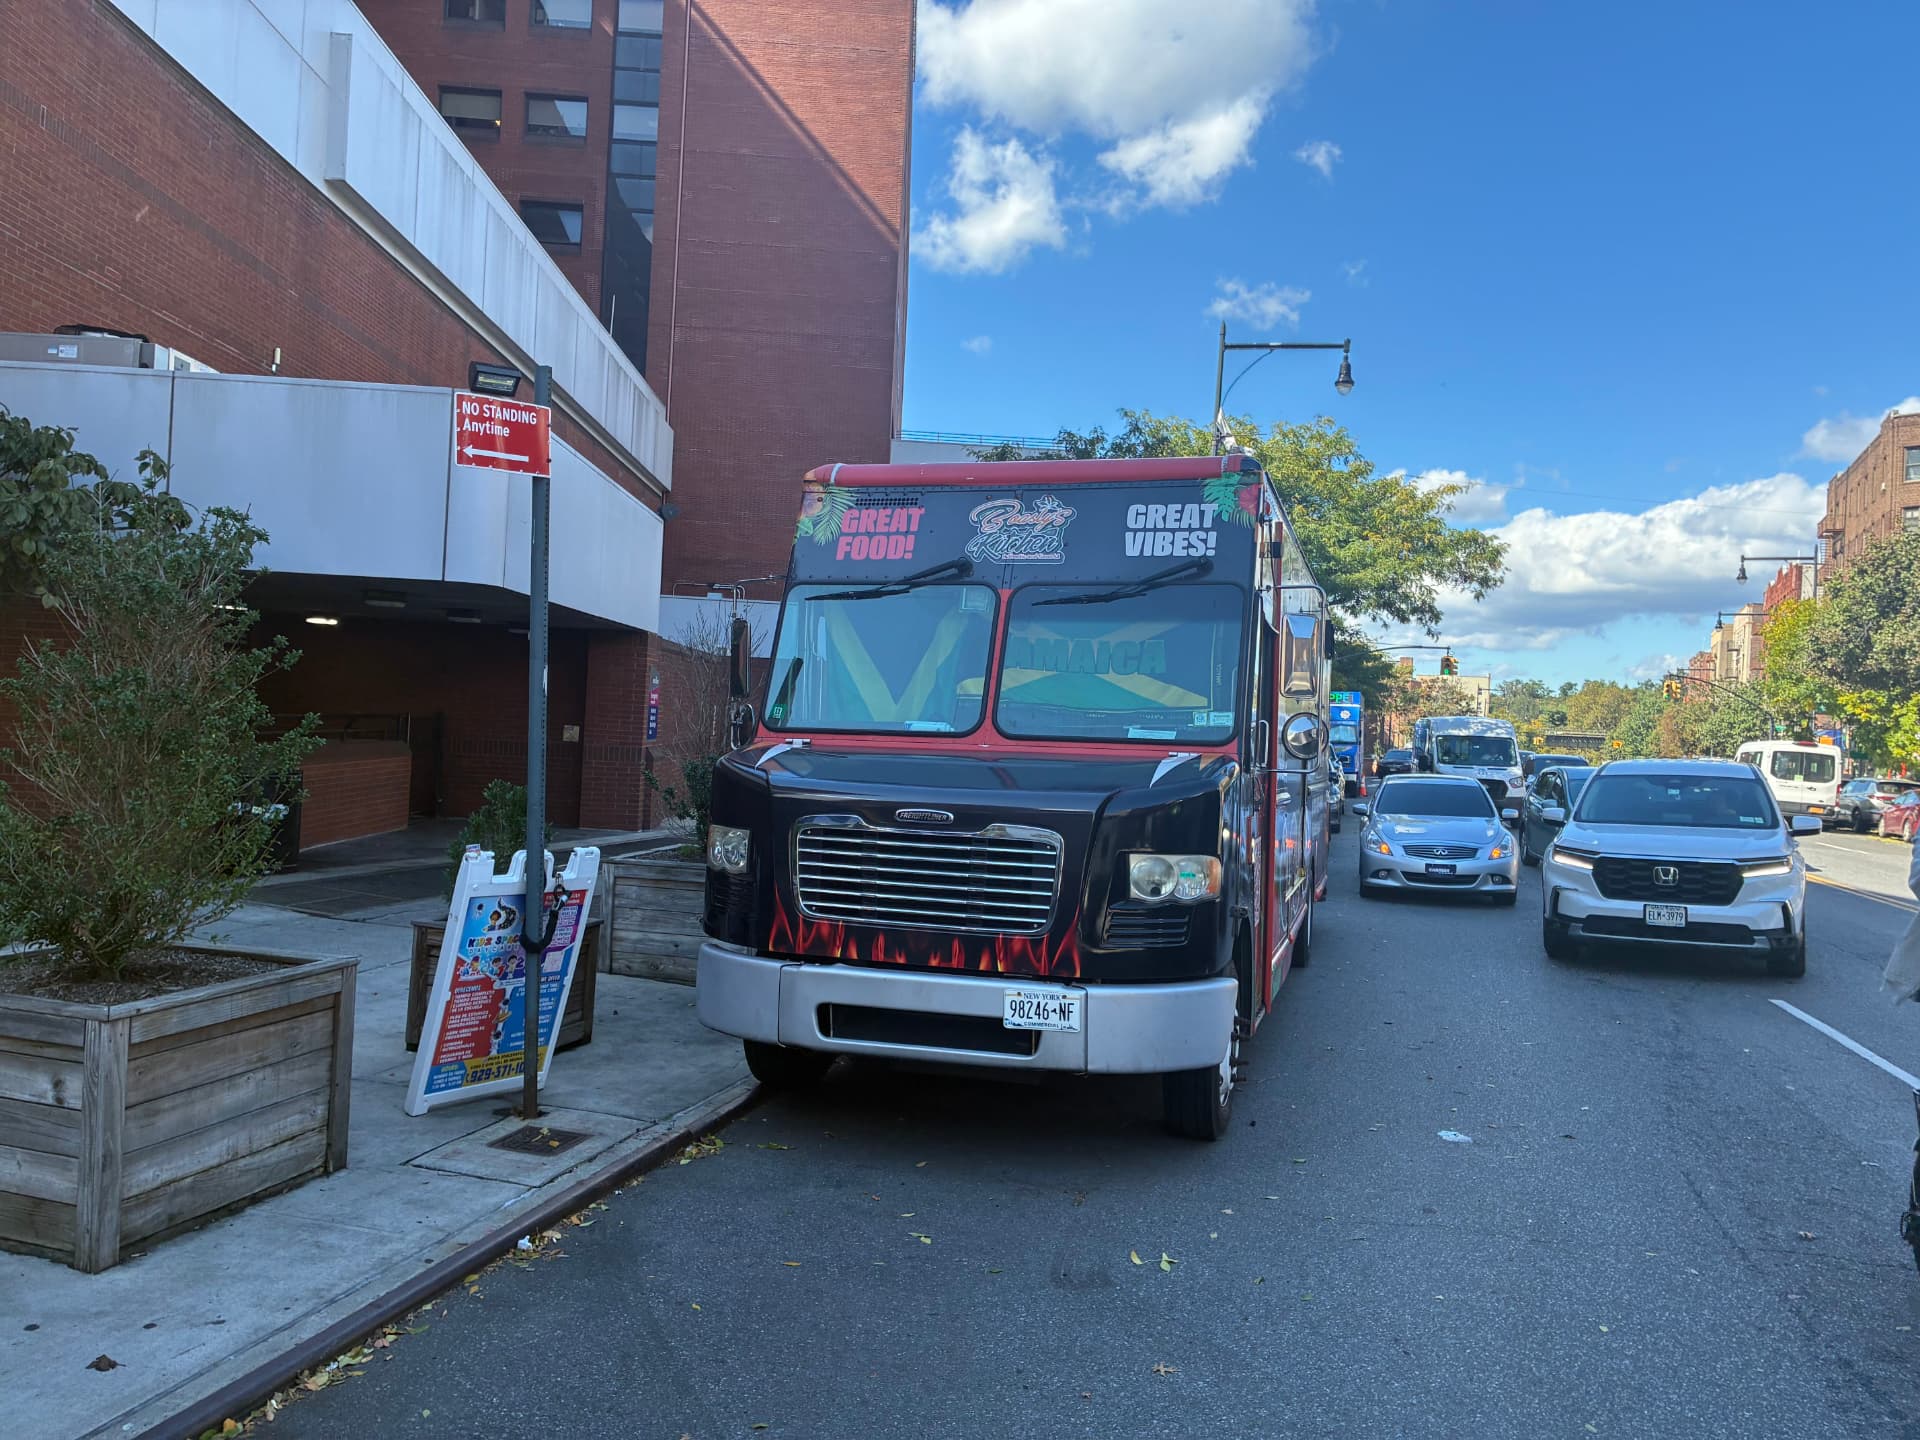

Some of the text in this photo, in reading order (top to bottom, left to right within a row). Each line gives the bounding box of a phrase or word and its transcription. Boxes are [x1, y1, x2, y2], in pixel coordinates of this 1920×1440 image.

[462, 401, 537, 425] NO STANDING
[462, 418, 510, 437] Anytime
[841, 507, 925, 533] GREAT
[1126, 503, 1218, 529] GREAT
[836, 534, 915, 560] FOOD!
[967, 530, 1059, 560] Kitchen
[1125, 530, 1217, 557] VIBES!
[1004, 636, 1167, 675] AMAICA
[495, 934, 520, 945] SPAC
[1023, 992, 1061, 1001] NEW YORK
[1010, 999, 1075, 1022] 98246-NF
